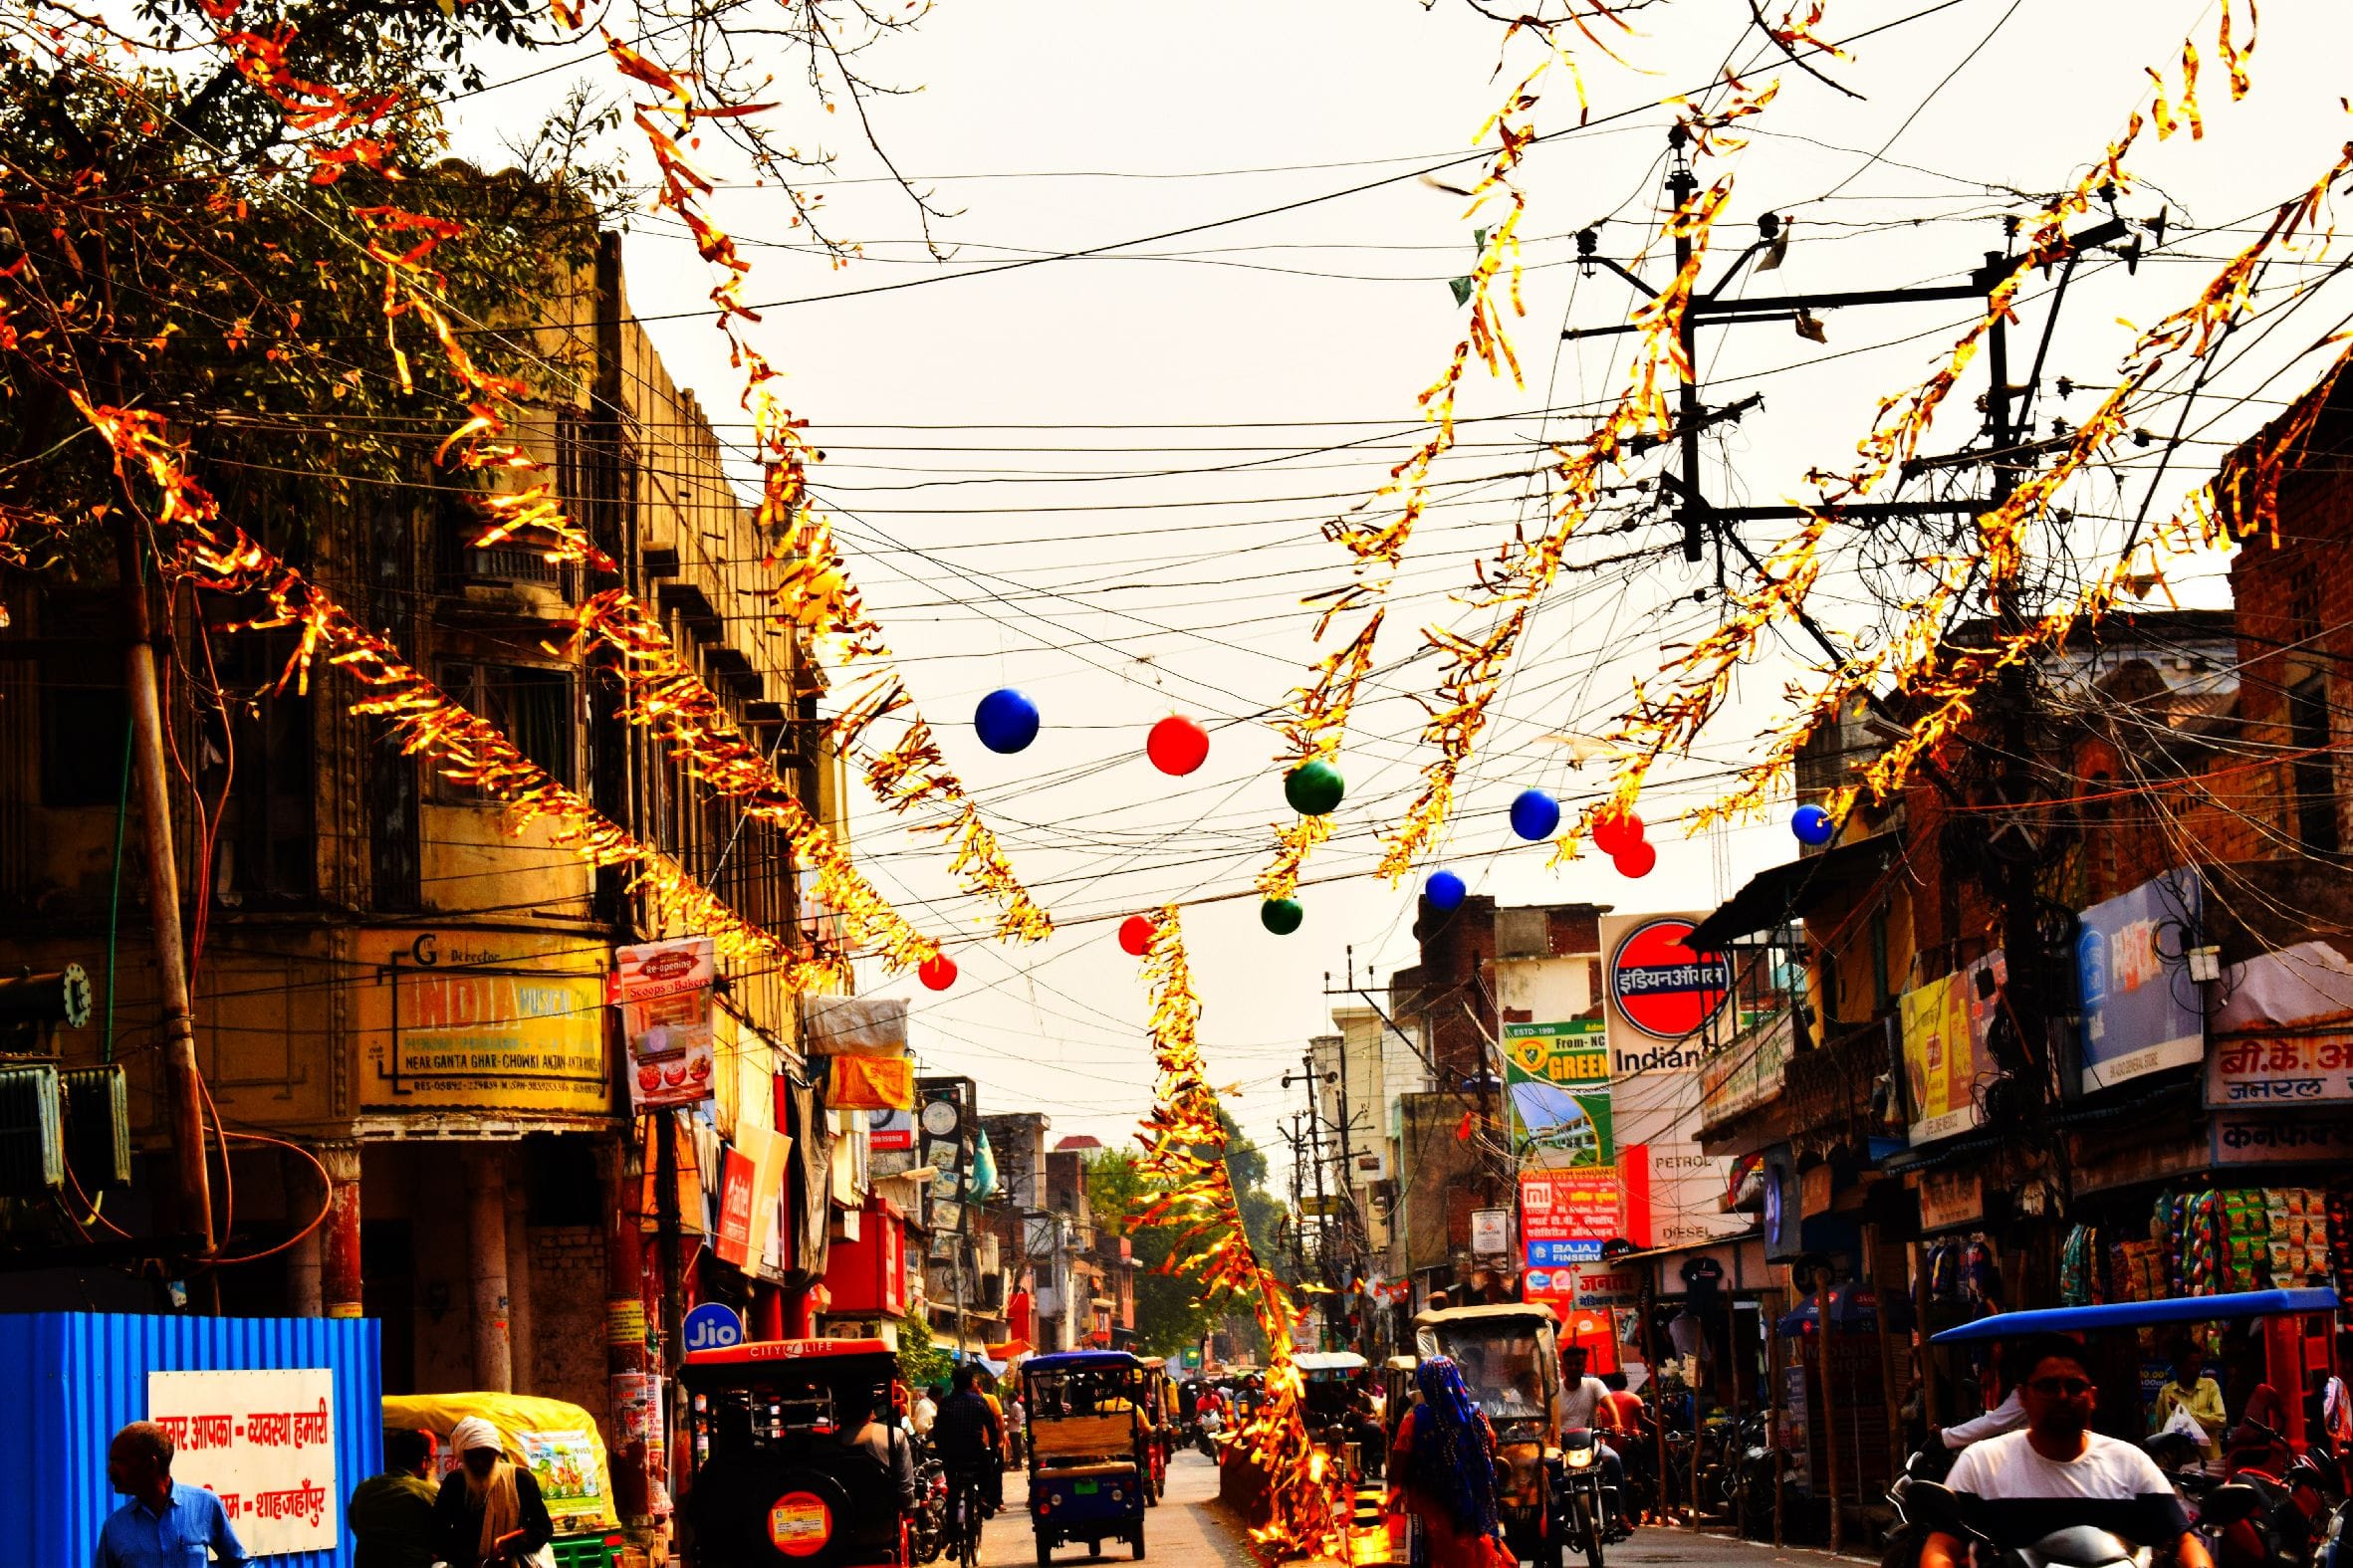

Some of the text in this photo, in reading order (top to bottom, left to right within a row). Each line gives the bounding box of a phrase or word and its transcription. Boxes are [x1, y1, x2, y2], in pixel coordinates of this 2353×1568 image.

[646, 960, 692, 974] Re-opening
[630, 978, 710, 998] Scoops Bakers
[407, 976, 522, 1031] INDIA
[1555, 1037, 1588, 1049] From-
[405, 1055, 432, 1070] NEAR
[434, 1054, 467, 1069] GANTA
[2224, 1077, 2328, 1100] जनरल
[1655, 1155, 1713, 1169] PETROL
[1552, 1243, 1601, 1253] BAJAJ
[1552, 1252, 1601, 1262] FINSERV
[1579, 1273, 1634, 1292] जनता
[689, 1318, 737, 1347] Jio
[750, 1341, 832, 1357] CITY LIFE
[190, 1415, 233, 1452] आपका
[247, 1413, 292, 1448] व्यवस्था
[293, 1397, 329, 1450] हमारी
[256, 1477, 327, 1528] शाहजहाँपुर
